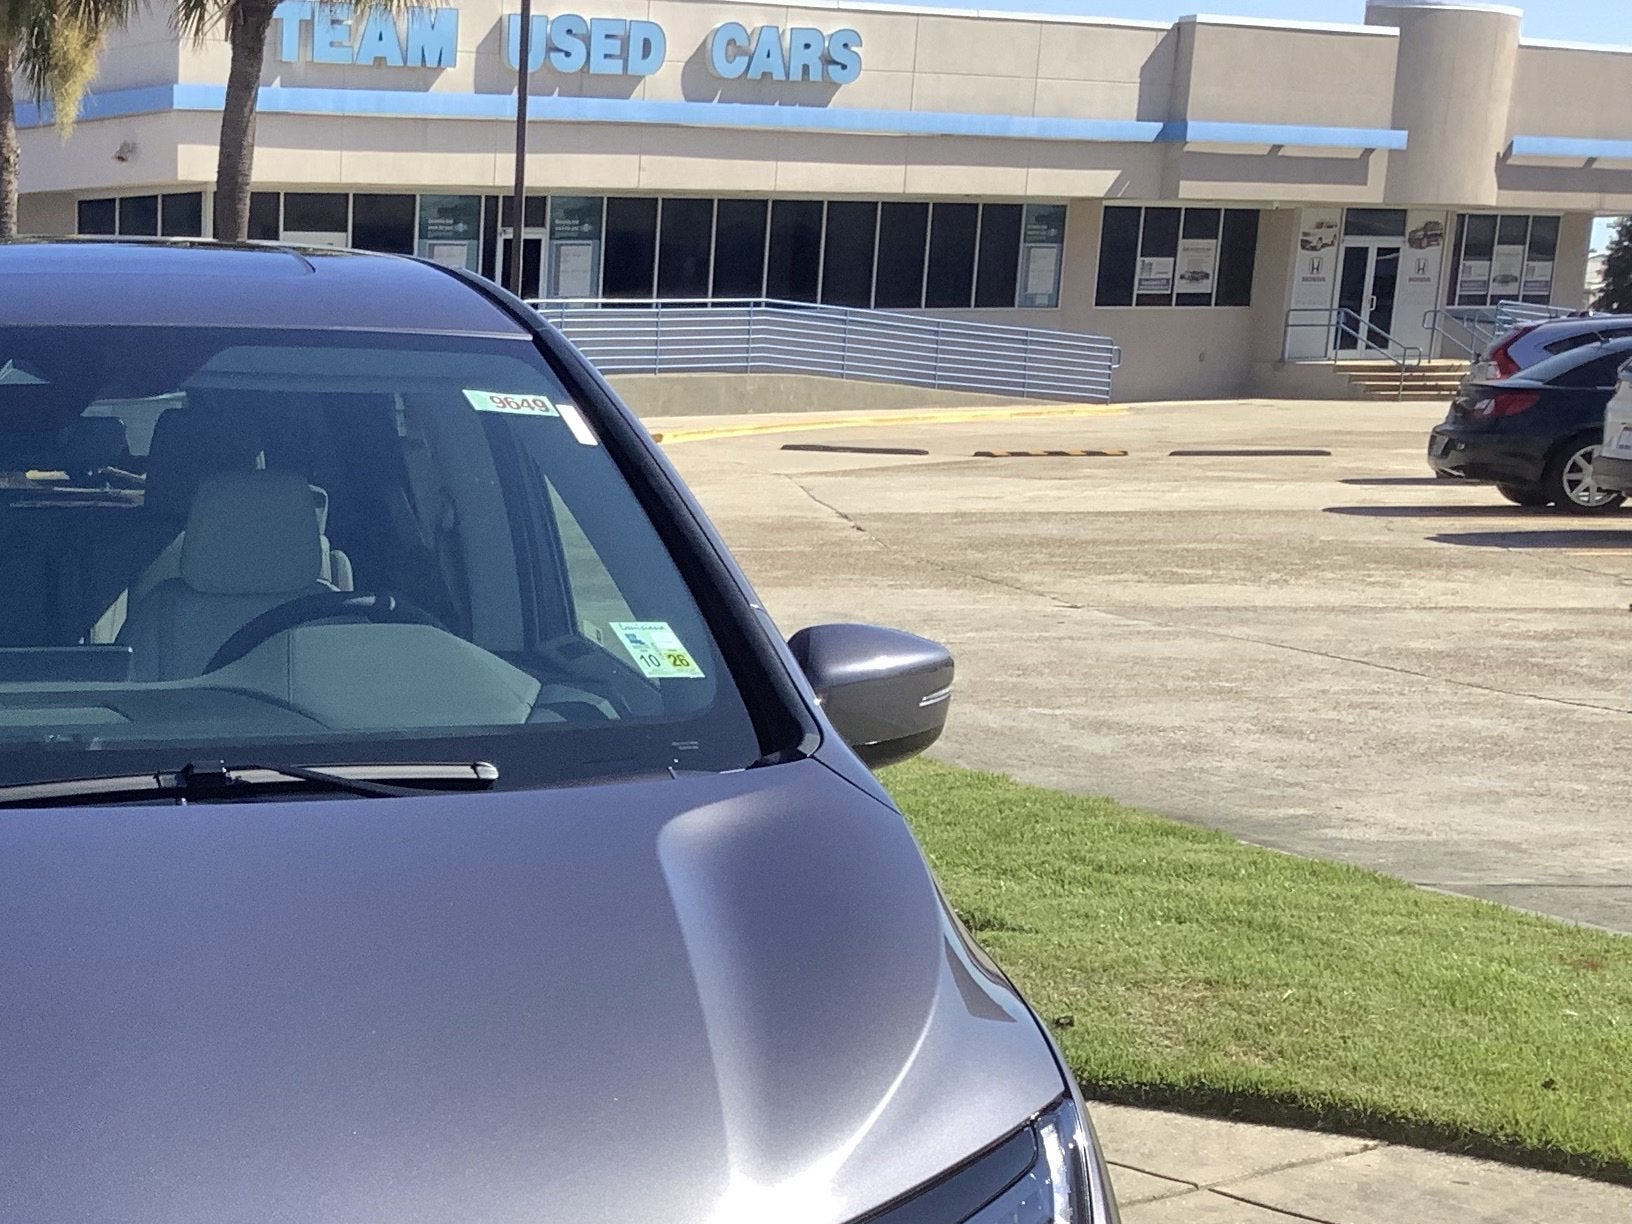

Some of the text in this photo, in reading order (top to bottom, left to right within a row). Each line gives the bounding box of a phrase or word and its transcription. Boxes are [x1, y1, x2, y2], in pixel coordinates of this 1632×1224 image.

[271, 0, 863, 85] TEAM USED CARS
[489, 395, 550, 413] 9649
[639, 654, 690, 668] 10 26
